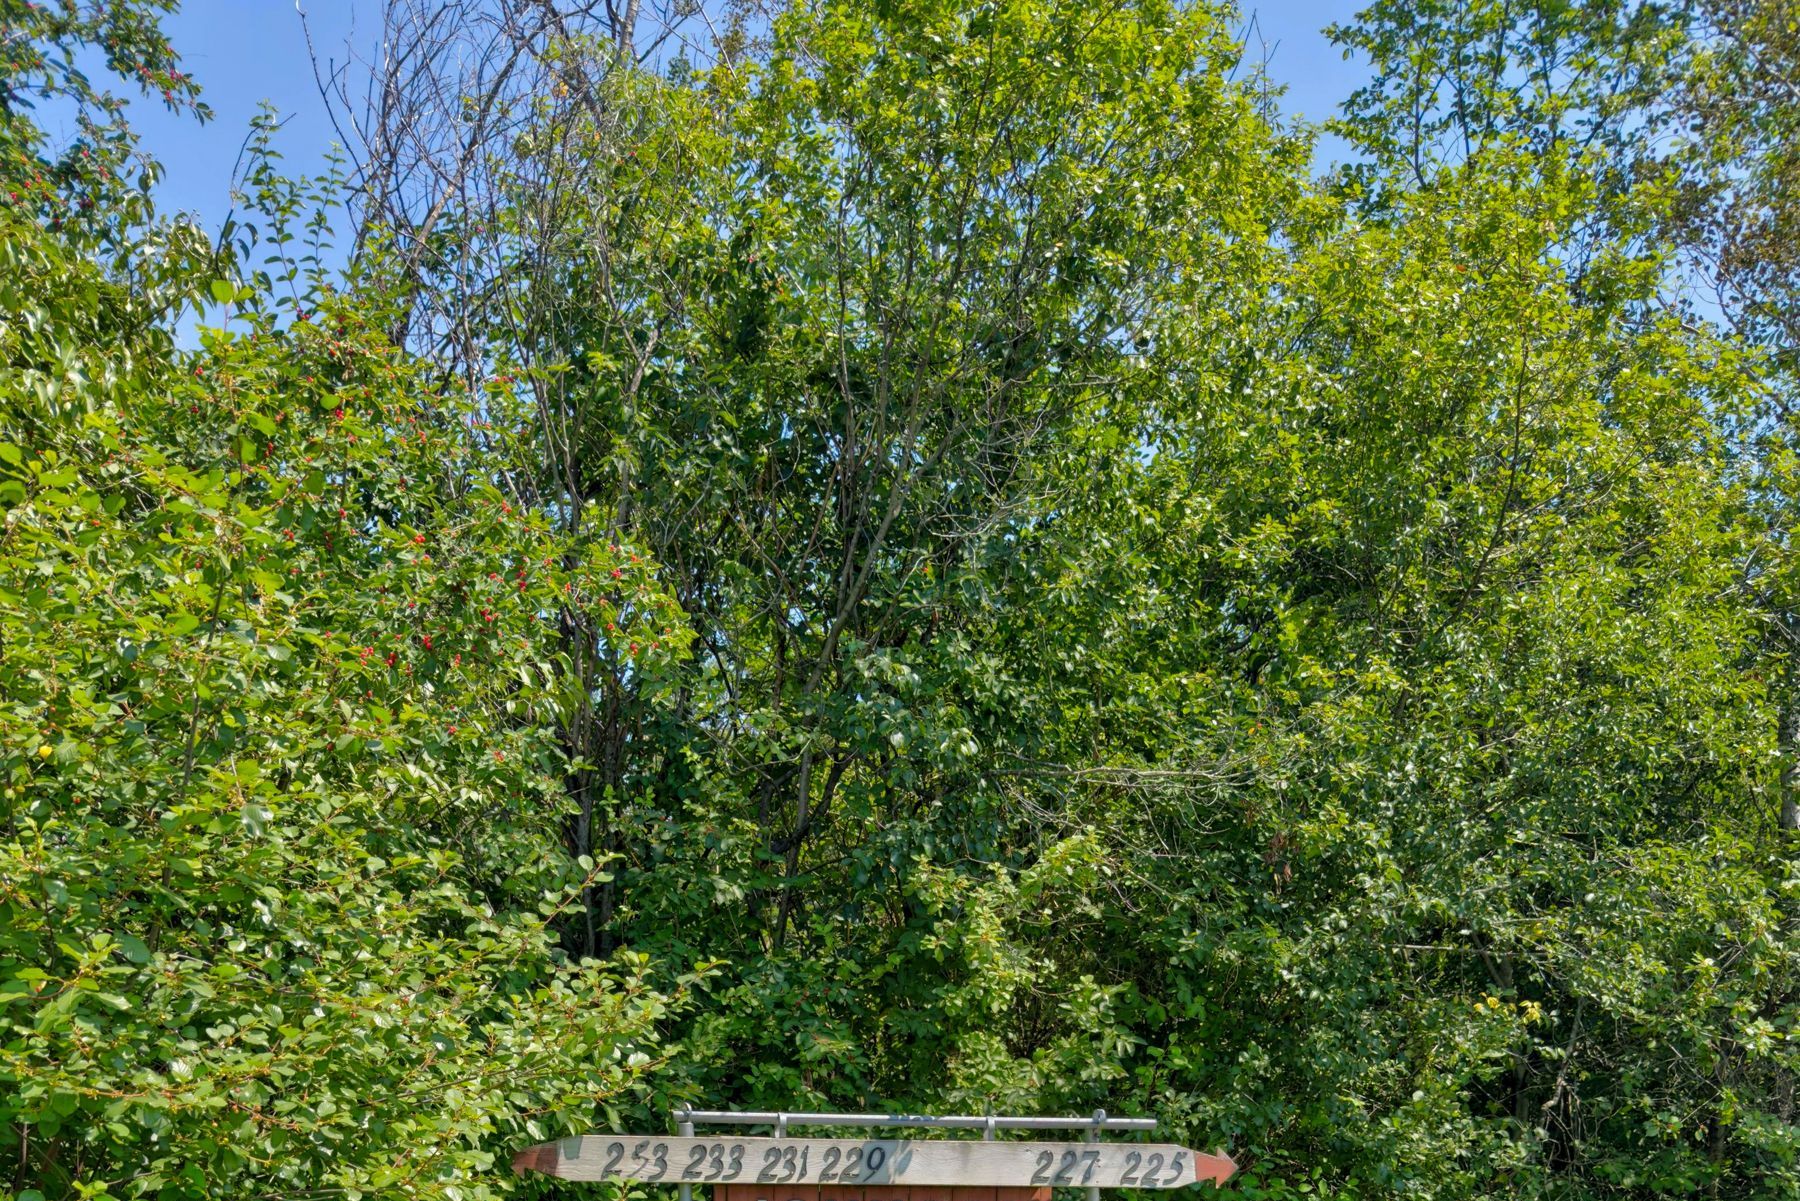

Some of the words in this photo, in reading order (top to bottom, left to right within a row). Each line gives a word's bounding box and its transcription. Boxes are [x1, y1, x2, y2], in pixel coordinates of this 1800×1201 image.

[601, 1140, 669, 1182] 253
[681, 1144, 746, 1182] 233
[756, 1145, 810, 1184] 231
[818, 1146, 886, 1184] 229
[1030, 1150, 1100, 1186] 227
[1120, 1151, 1188, 1187] 225
